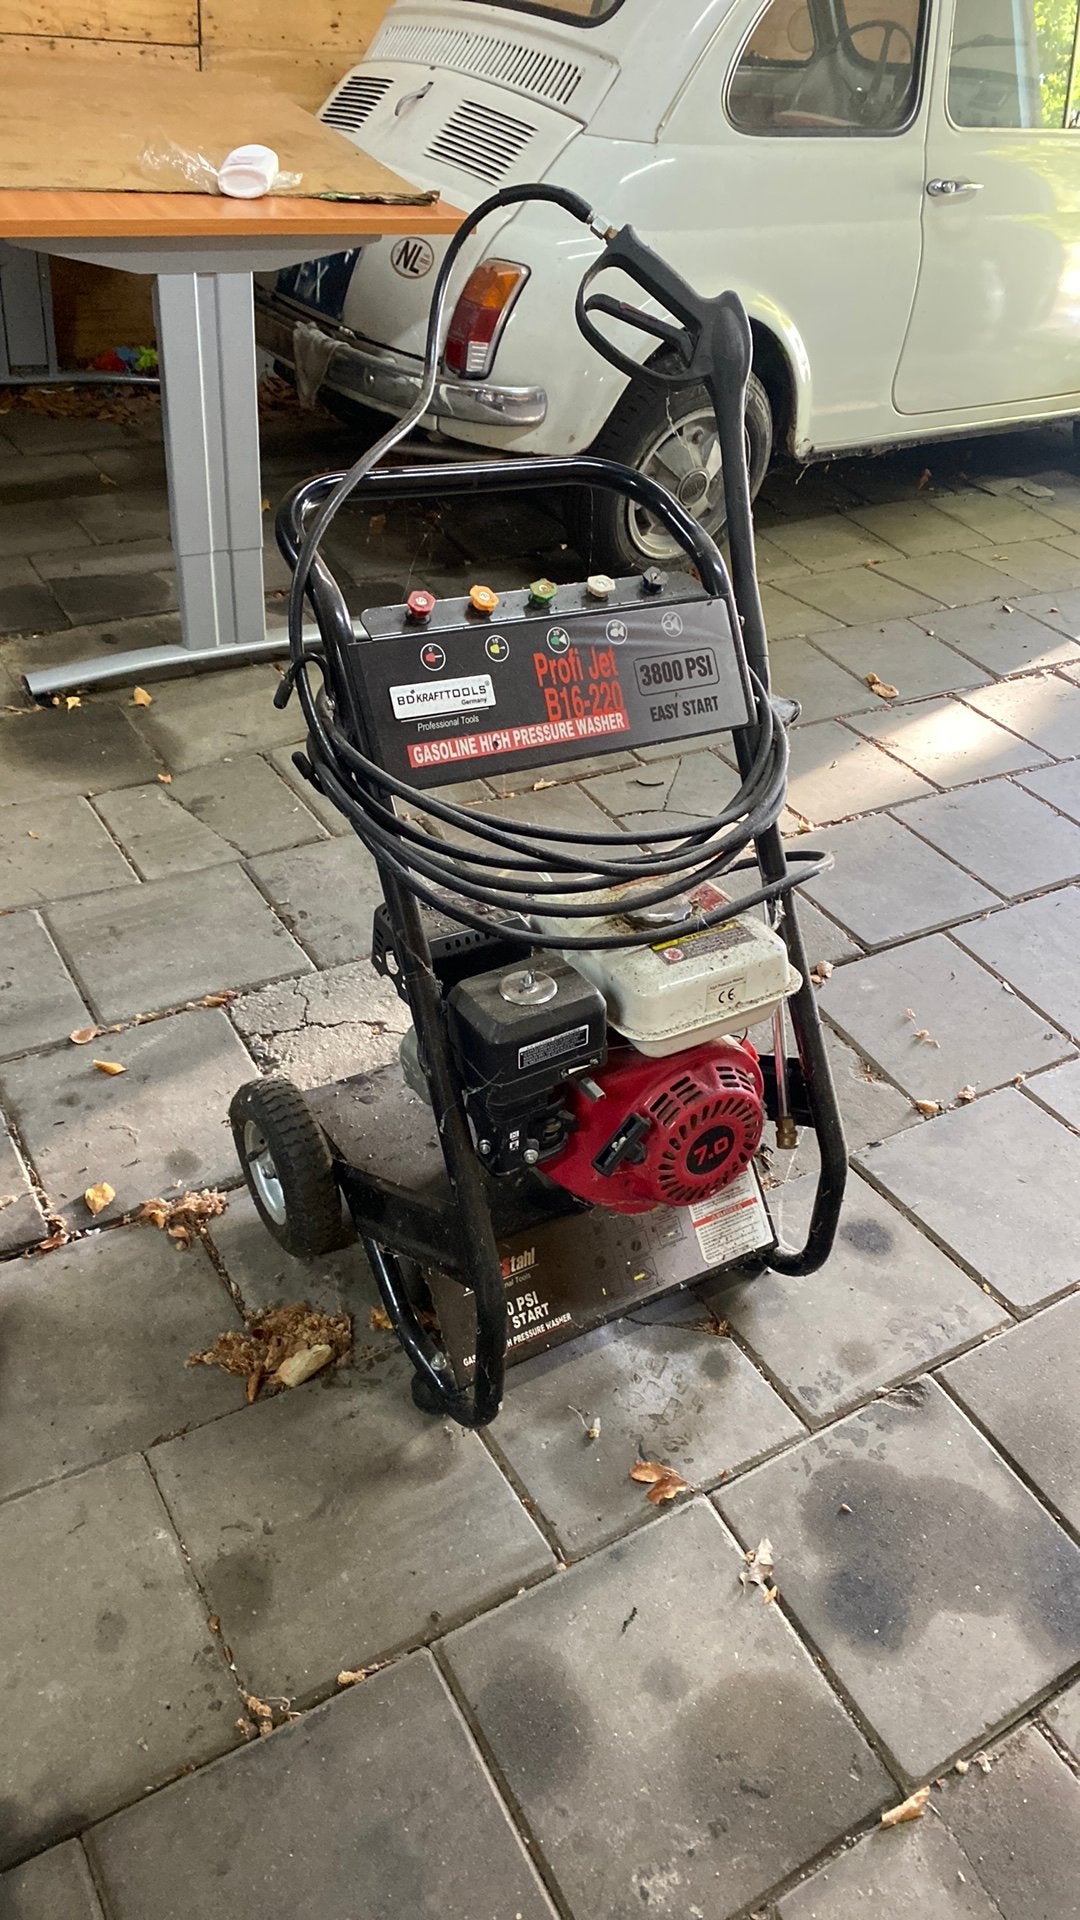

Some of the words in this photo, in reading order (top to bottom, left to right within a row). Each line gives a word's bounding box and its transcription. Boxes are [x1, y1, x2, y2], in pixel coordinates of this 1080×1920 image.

[395, 240, 423, 274] NL
[533, 647, 584, 687] Profi
[588, 645, 619, 680] Jet
[640, 659, 684, 687] 3800
[685, 655, 713, 680] PSI
[461, 697, 487, 706] Germany
[544, 681, 624, 721] B16-220
[650, 702, 679, 722] EASY
[682, 696, 719, 717] START
[413, 737, 478, 764] GASOLINE
[479, 731, 512, 753] HIGH
[513, 722, 575, 746] PRESSURE
[577, 713, 625, 735] WASHER
[417, 718, 459, 732] Professional
[461, 715, 480, 725] Tools
[693, 1136, 729, 1167] 7.0
[512, 1302, 550, 1329] START
[516, 1291, 539, 1311] PSI
[513, 1323, 546, 1345] PRESSURE
[545, 1312, 573, 1330] WASHER
